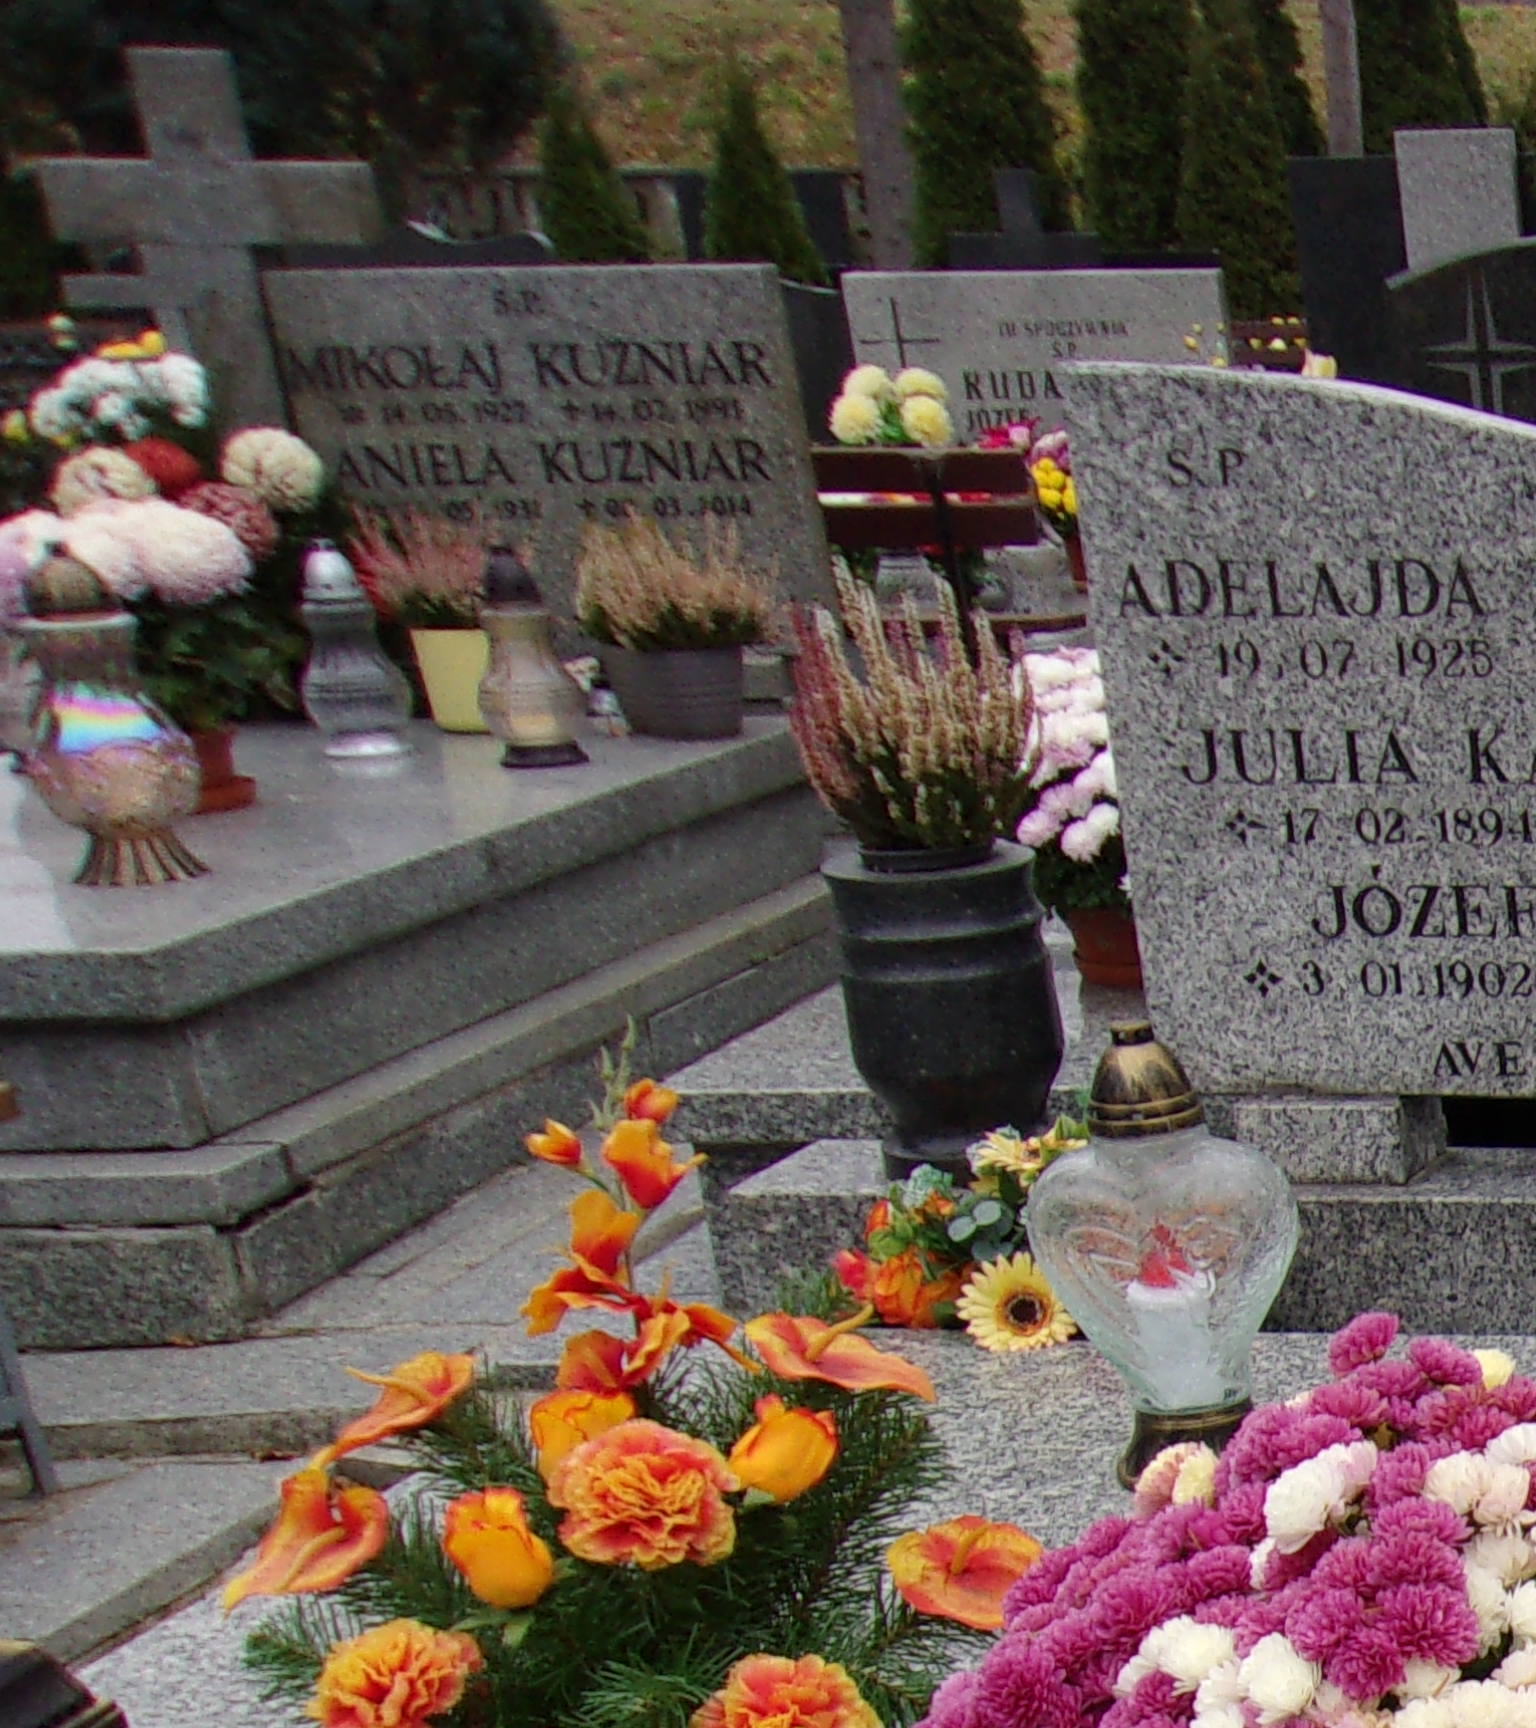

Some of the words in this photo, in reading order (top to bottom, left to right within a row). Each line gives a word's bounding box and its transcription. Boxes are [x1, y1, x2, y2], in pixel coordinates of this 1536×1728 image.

[337, 444, 517, 490] ANIELA
[1119, 556, 1489, 619] ADELAJDA
[1182, 727, 1420, 787] JULIA
[1432, 1040, 1523, 1079] AVE
